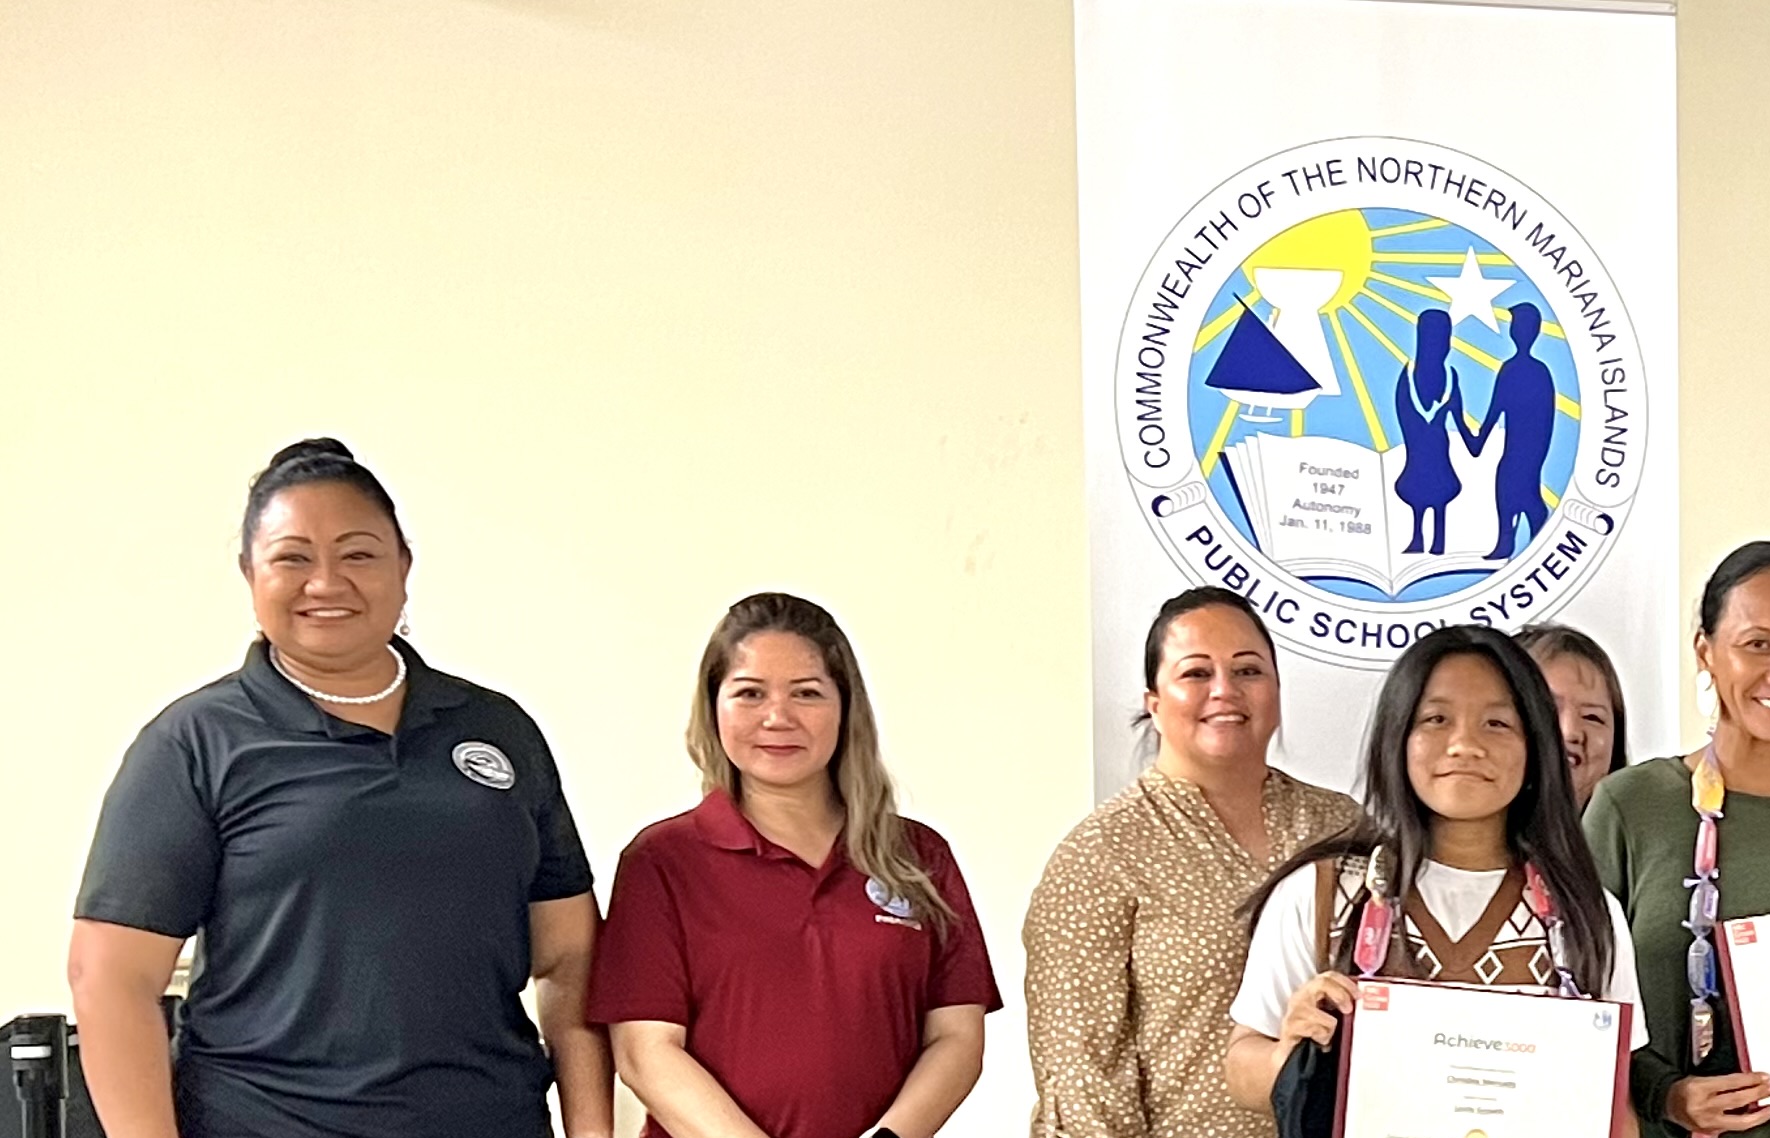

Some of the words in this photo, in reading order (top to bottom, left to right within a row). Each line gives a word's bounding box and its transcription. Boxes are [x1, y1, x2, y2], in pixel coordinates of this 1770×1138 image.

[1135, 210, 1239, 468] COMMONWEALTH
[1237, 181, 1275, 219] OF
[1281, 159, 1348, 196] THE
[1357, 156, 1528, 231] NORTHERN
[1525, 221, 1617, 353] MARIANA
[1595, 357, 1629, 489] ISLANDS
[1299, 462, 1360, 480] Founded
[1312, 482, 1346, 496] 1947
[1292, 498, 1361, 519] Autonomy
[1279, 514, 1309, 529] Jan.
[1340, 521, 1372, 535] 1988
[1185, 524, 1301, 624] PUBLIC
[1469, 530, 1589, 628] SYSTEM
